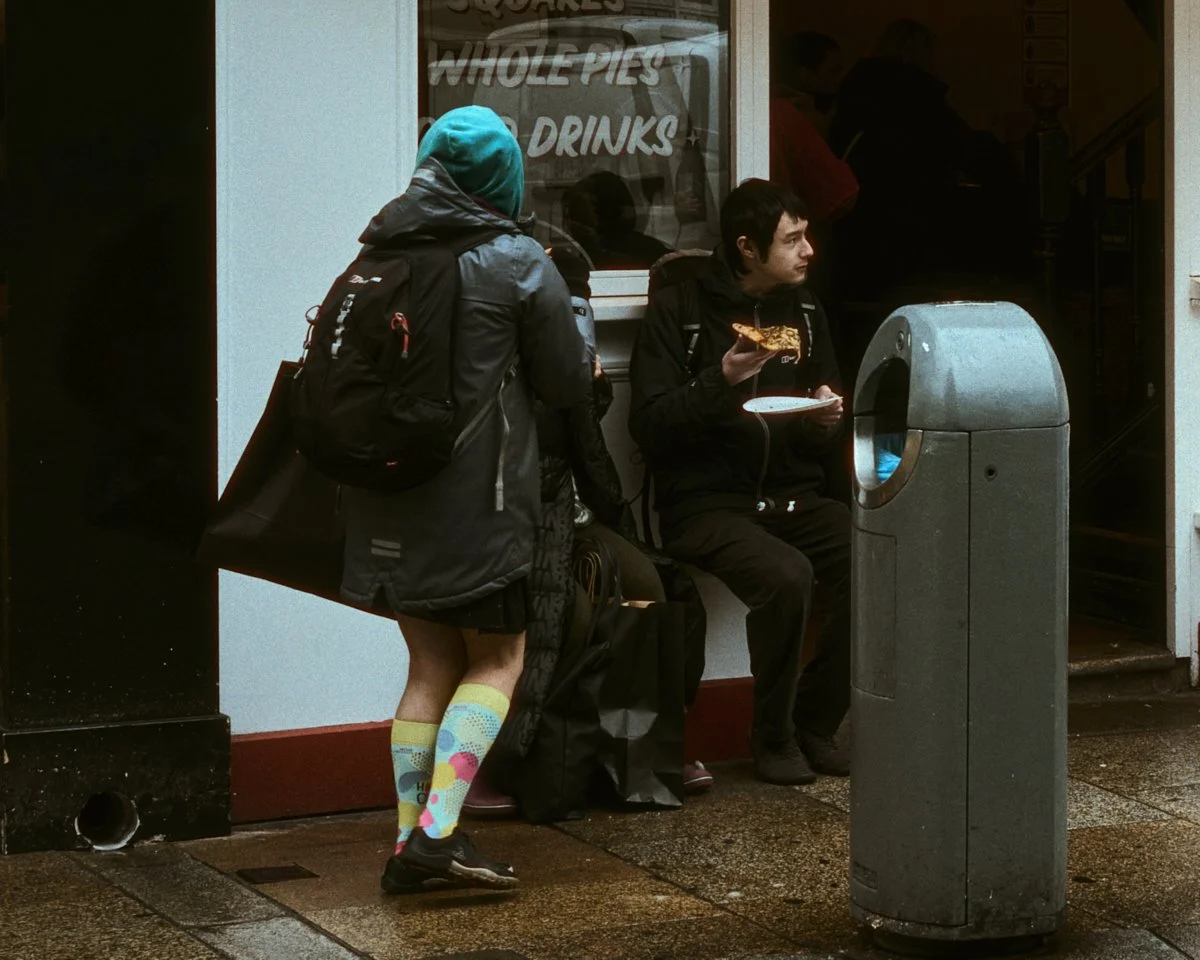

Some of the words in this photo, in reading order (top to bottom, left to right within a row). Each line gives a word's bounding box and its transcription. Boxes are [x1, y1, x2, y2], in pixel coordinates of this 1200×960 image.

[427, 41, 574, 88] WHOLE
[579, 42, 667, 86] PIES
[527, 115, 678, 158] DRINKS
